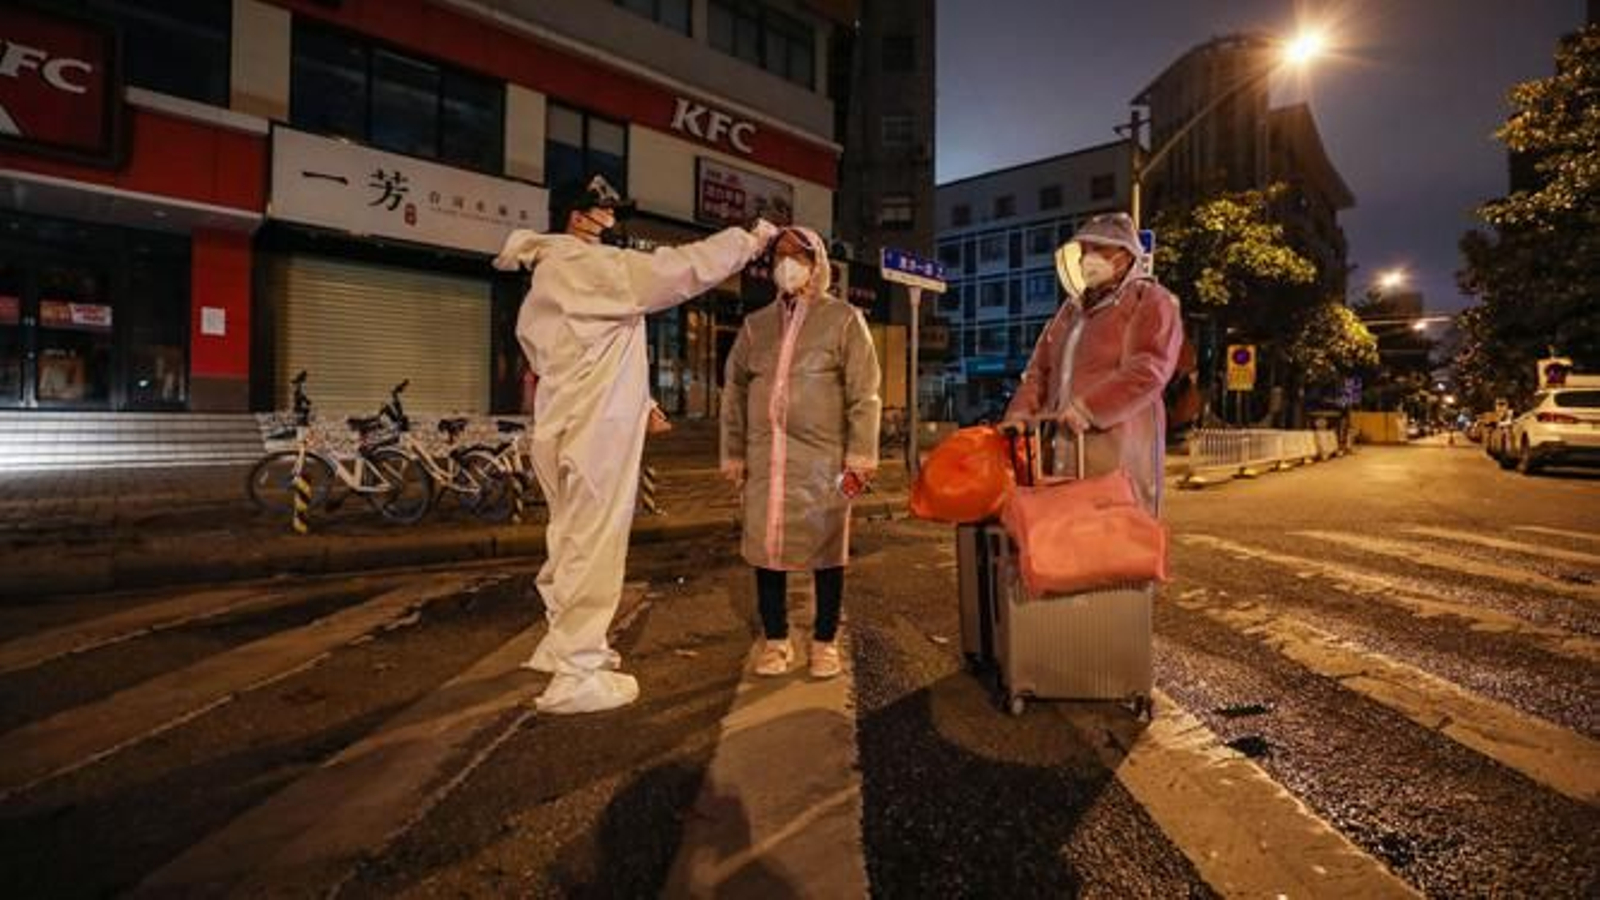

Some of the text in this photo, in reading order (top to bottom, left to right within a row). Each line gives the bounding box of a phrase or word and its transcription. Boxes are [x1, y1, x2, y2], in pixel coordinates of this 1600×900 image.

[0, 40, 92, 94] FC
[671, 97, 756, 153] KFC
[302, 168, 409, 211] 一芳
